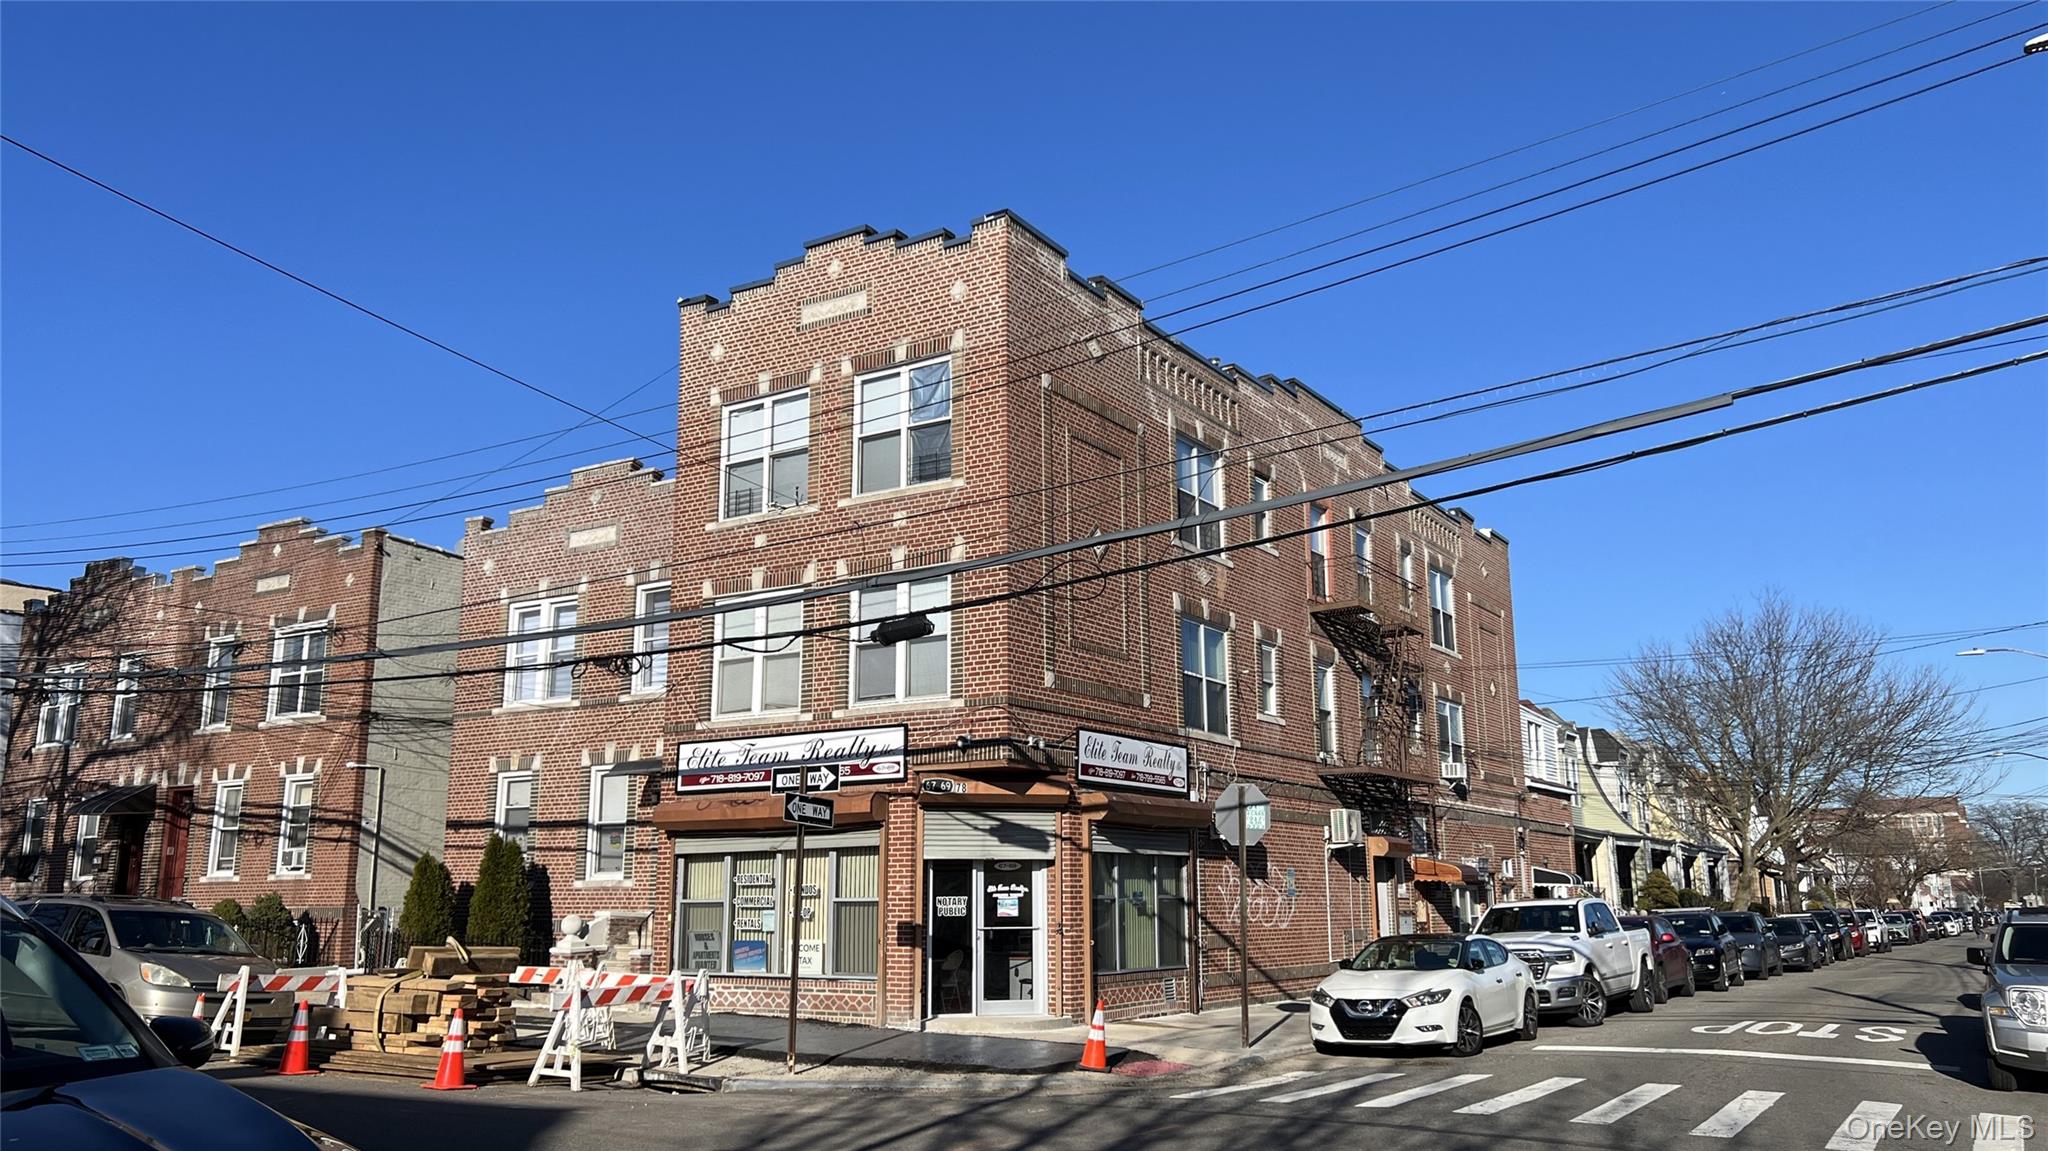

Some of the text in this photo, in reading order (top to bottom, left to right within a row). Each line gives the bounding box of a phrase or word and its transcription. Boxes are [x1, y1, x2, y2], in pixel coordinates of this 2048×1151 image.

[687, 747, 726, 769] Elite
[736, 743, 789, 766] Team
[801, 735, 876, 767] Realty
[1084, 736, 1107, 760] Elite
[1111, 741, 1138, 765] Team
[1142, 746, 1176, 781] Realty
[710, 772, 765, 784] 718-819-7097
[781, 772, 829, 786] ONE WAY
[791, 802, 828, 817] ONE WAY
[737, 874, 772, 884] RESIDENTIAL
[737, 896, 773, 906] COMMERCIAL
[936, 897, 967, 906] NOTARY
[938, 907, 966, 916] PUBLIC
[737, 919, 761, 928] RENTALS
[1691, 1020, 1908, 1042] STOP
